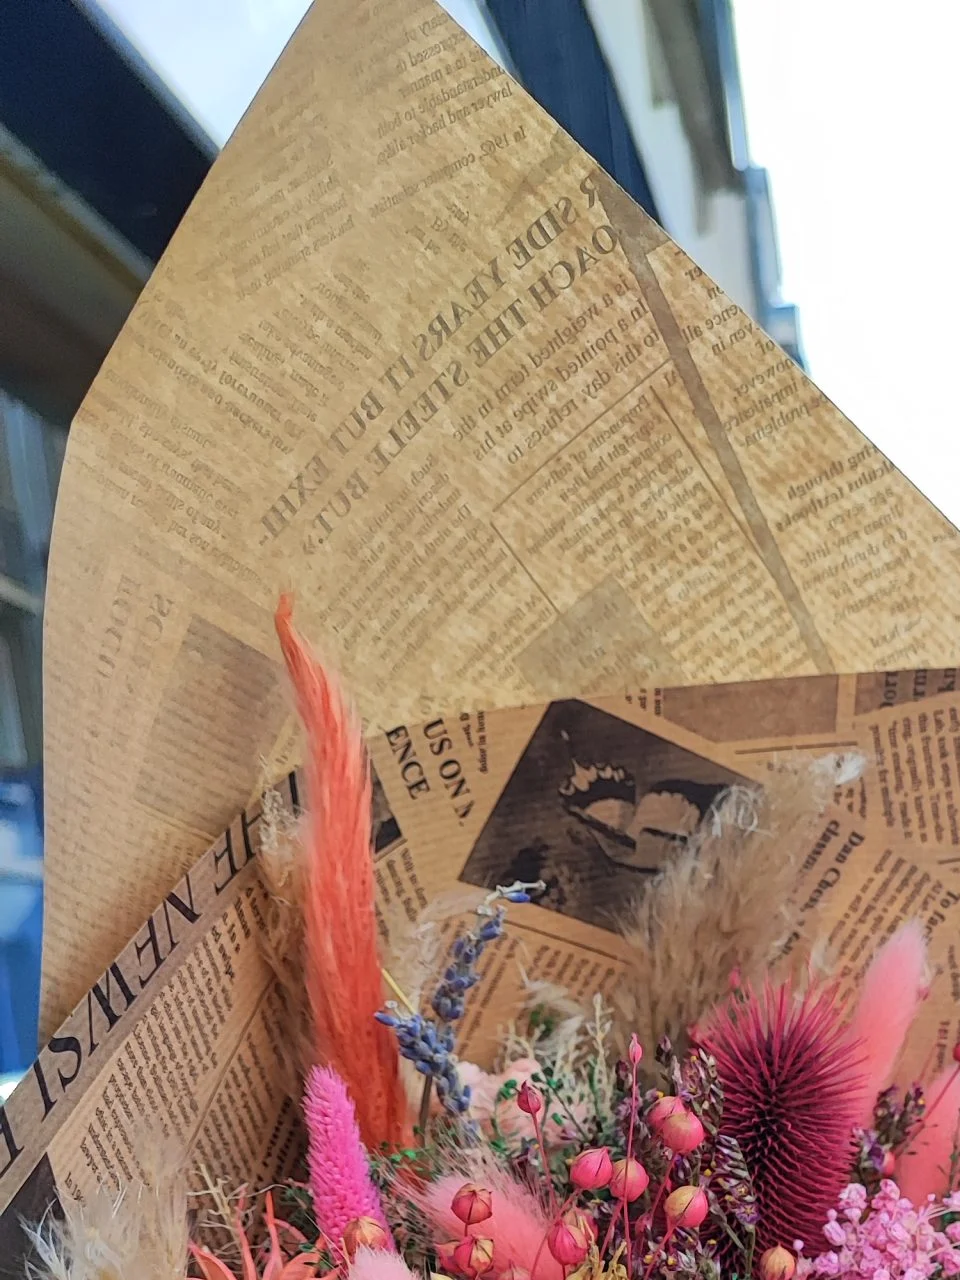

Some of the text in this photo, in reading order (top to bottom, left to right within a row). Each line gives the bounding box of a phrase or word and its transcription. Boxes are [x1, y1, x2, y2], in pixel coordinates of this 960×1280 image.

[385, 726, 430, 799] ENCE
[440, 760, 470, 798] ON
[835, 832, 864, 863] Dan
